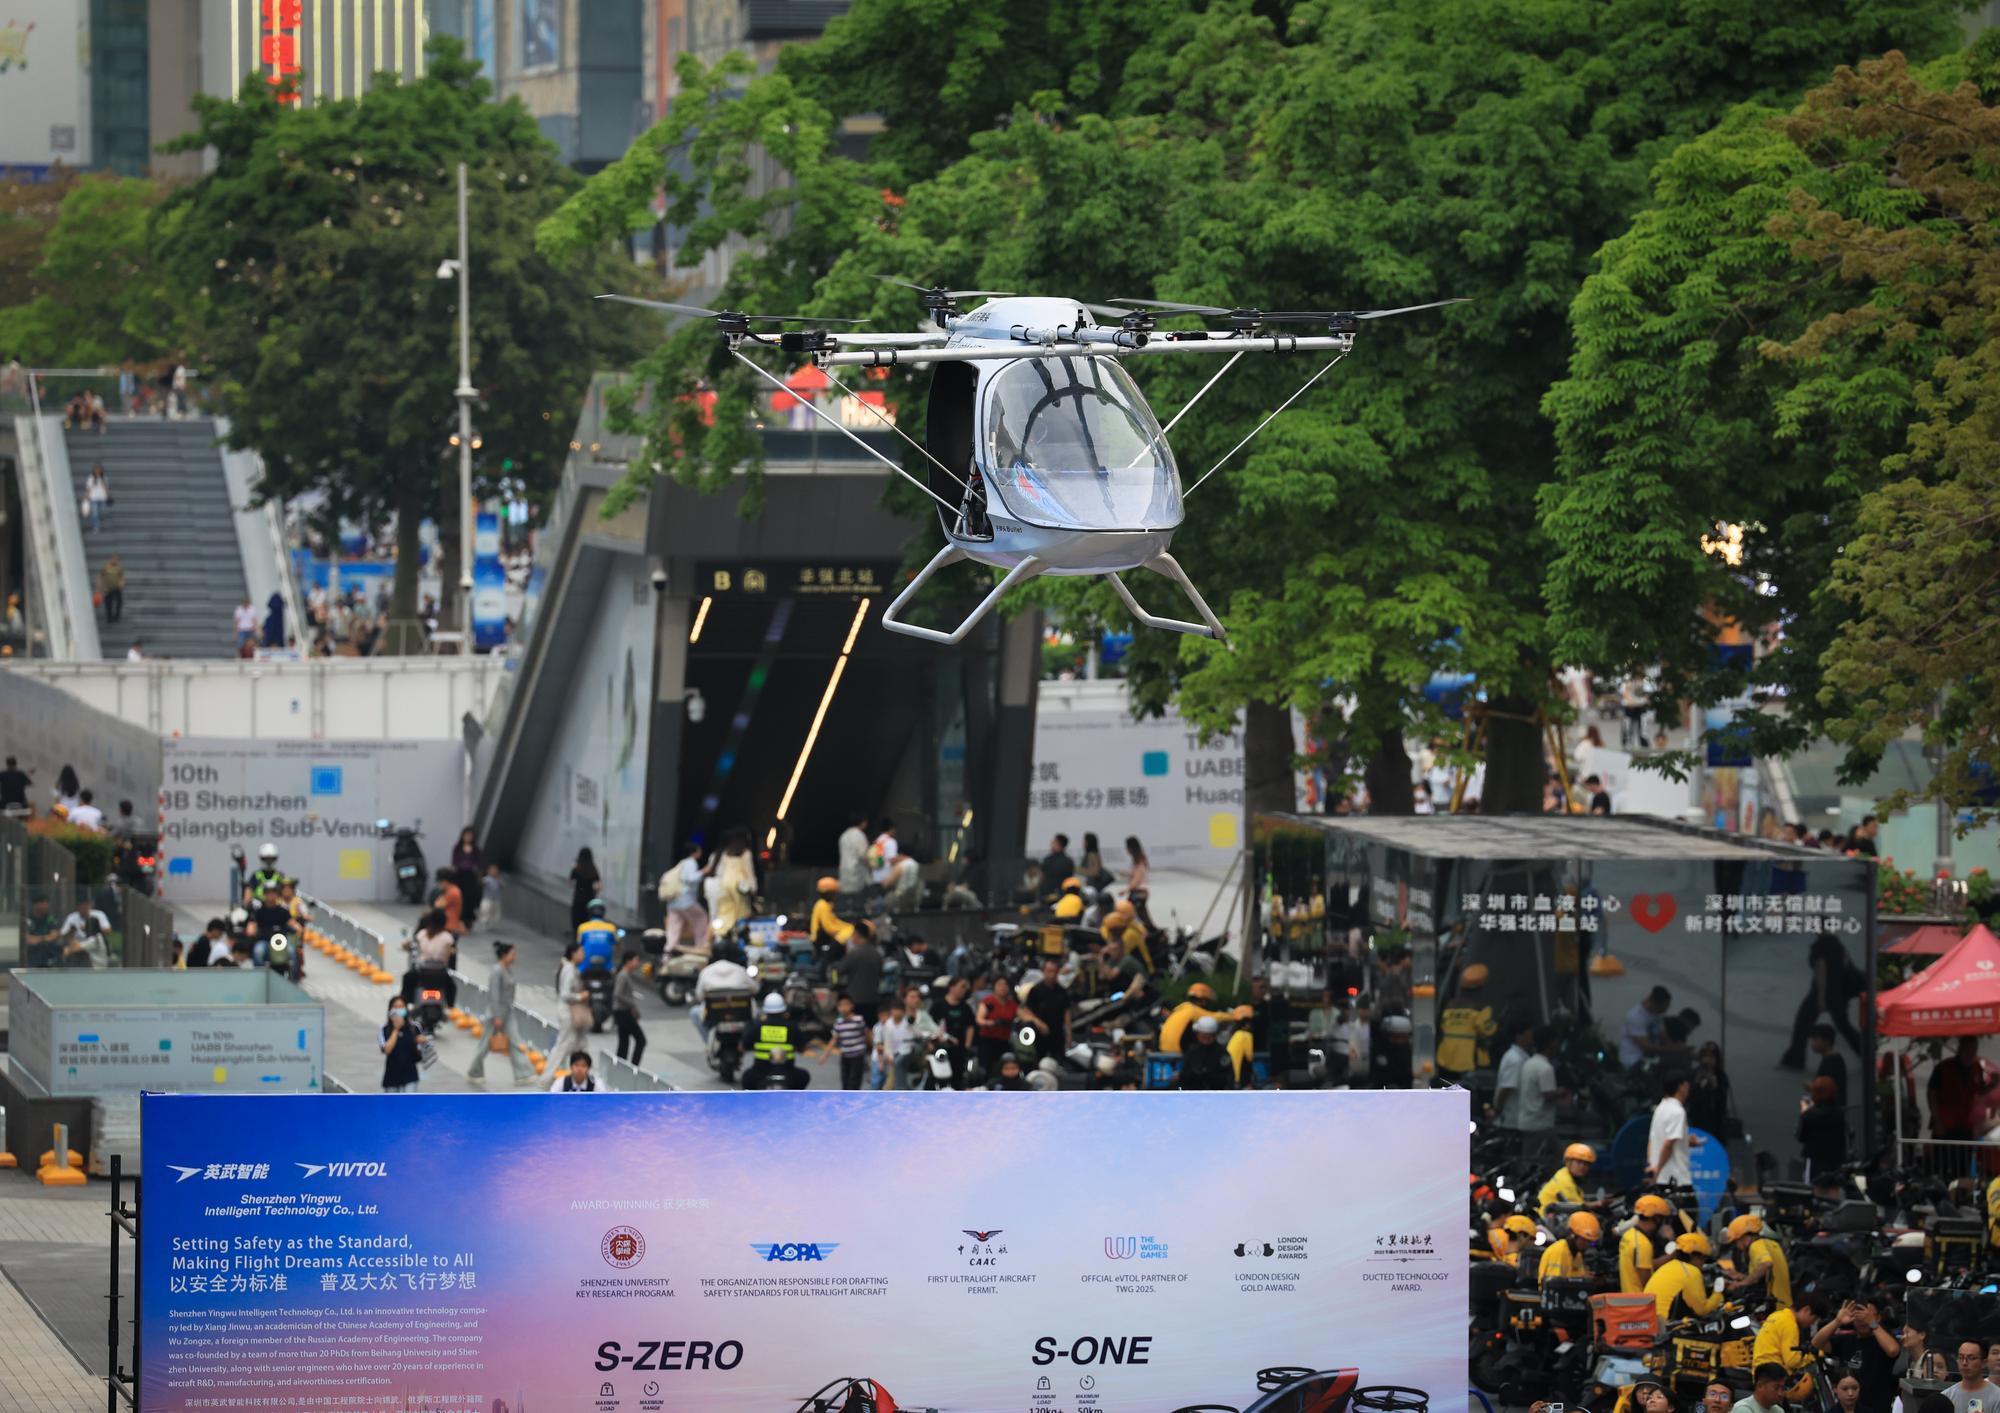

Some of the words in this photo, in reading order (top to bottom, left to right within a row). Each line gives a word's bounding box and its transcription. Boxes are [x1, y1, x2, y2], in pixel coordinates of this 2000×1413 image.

[715, 572, 730, 589] B
[170, 764, 218, 784] 10th
[196, 791, 308, 810] Shenzhen
[163, 818, 263, 842] qiangbei
[1463, 895, 1621, 911] 深圳市血液中心
[1706, 896, 1841, 912] 深圳市无偿献血
[1686, 916, 1861, 932] 新时代文明实践中心
[192, 1032, 210, 1040] The
[213, 1032, 234, 1041] 10th
[191, 1044, 222, 1052] UABB
[224, 1044, 273, 1052] Shenzhen
[192, 1056, 254, 1064] Huaqiangbei
[256, 1054, 311, 1063] Sub-Venue
[204, 1164, 270, 1179] 英武智能
[325, 1162, 387, 1177] YIVTOL
[241, 1195, 296, 1204] Shenzhen
[301, 1194, 341, 1204] Yingwu
[205, 1204, 261, 1217] Intelligent
[265, 1203, 330, 1216] Technology
[333, 1202, 354, 1215] Co.,
[358, 1205, 378, 1214] Ltd.
[173, 1238, 228, 1253] Setting
[234, 1236, 282, 1252] Safety
[288, 1239, 303, 1249] as
[308, 1236, 333, 1248] the
[339, 1235, 412, 1248] Standard,
[1278, 1243, 1304, 1251] DESIGN
[1141, 1250, 1168, 1258] GAMES
[1278, 1251, 1308, 1259] AWARDS
[173, 1257, 229, 1272] Making
[236, 1256, 280, 1272] Flight
[286, 1256, 343, 1268] Dreams
[348, 1254, 427, 1267] Accessible
[433, 1256, 448, 1266] to
[454, 1254, 472, 1266] All
[171, 1272, 288, 1292] 以安全为标准
[320, 1273, 476, 1290] 普及大众飞行梦想
[208, 1310, 237, 1318] Yingwu
[239, 1309, 277, 1318] Intelligent
[279, 1309, 323, 1317] Technology
[205, 1324, 226, 1332] Xiang
[415, 1321, 462, 1329] Engineering,
[183, 1338, 213, 1347] Zongze,
[221, 1337, 248, 1346] foreign
[384, 1335, 431, 1344] Engineering.
[371, 1349, 401, 1358] Beihang
[595, 1341, 743, 1371] S-ZERO
[1032, 1337, 1152, 1365] S-ONE
[189, 1366, 228, 1374] University,
[231, 1365, 252, 1374] along
[297, 1365, 334, 1373] engineers
[217, 1379, 275, 1387] manufacturing,
